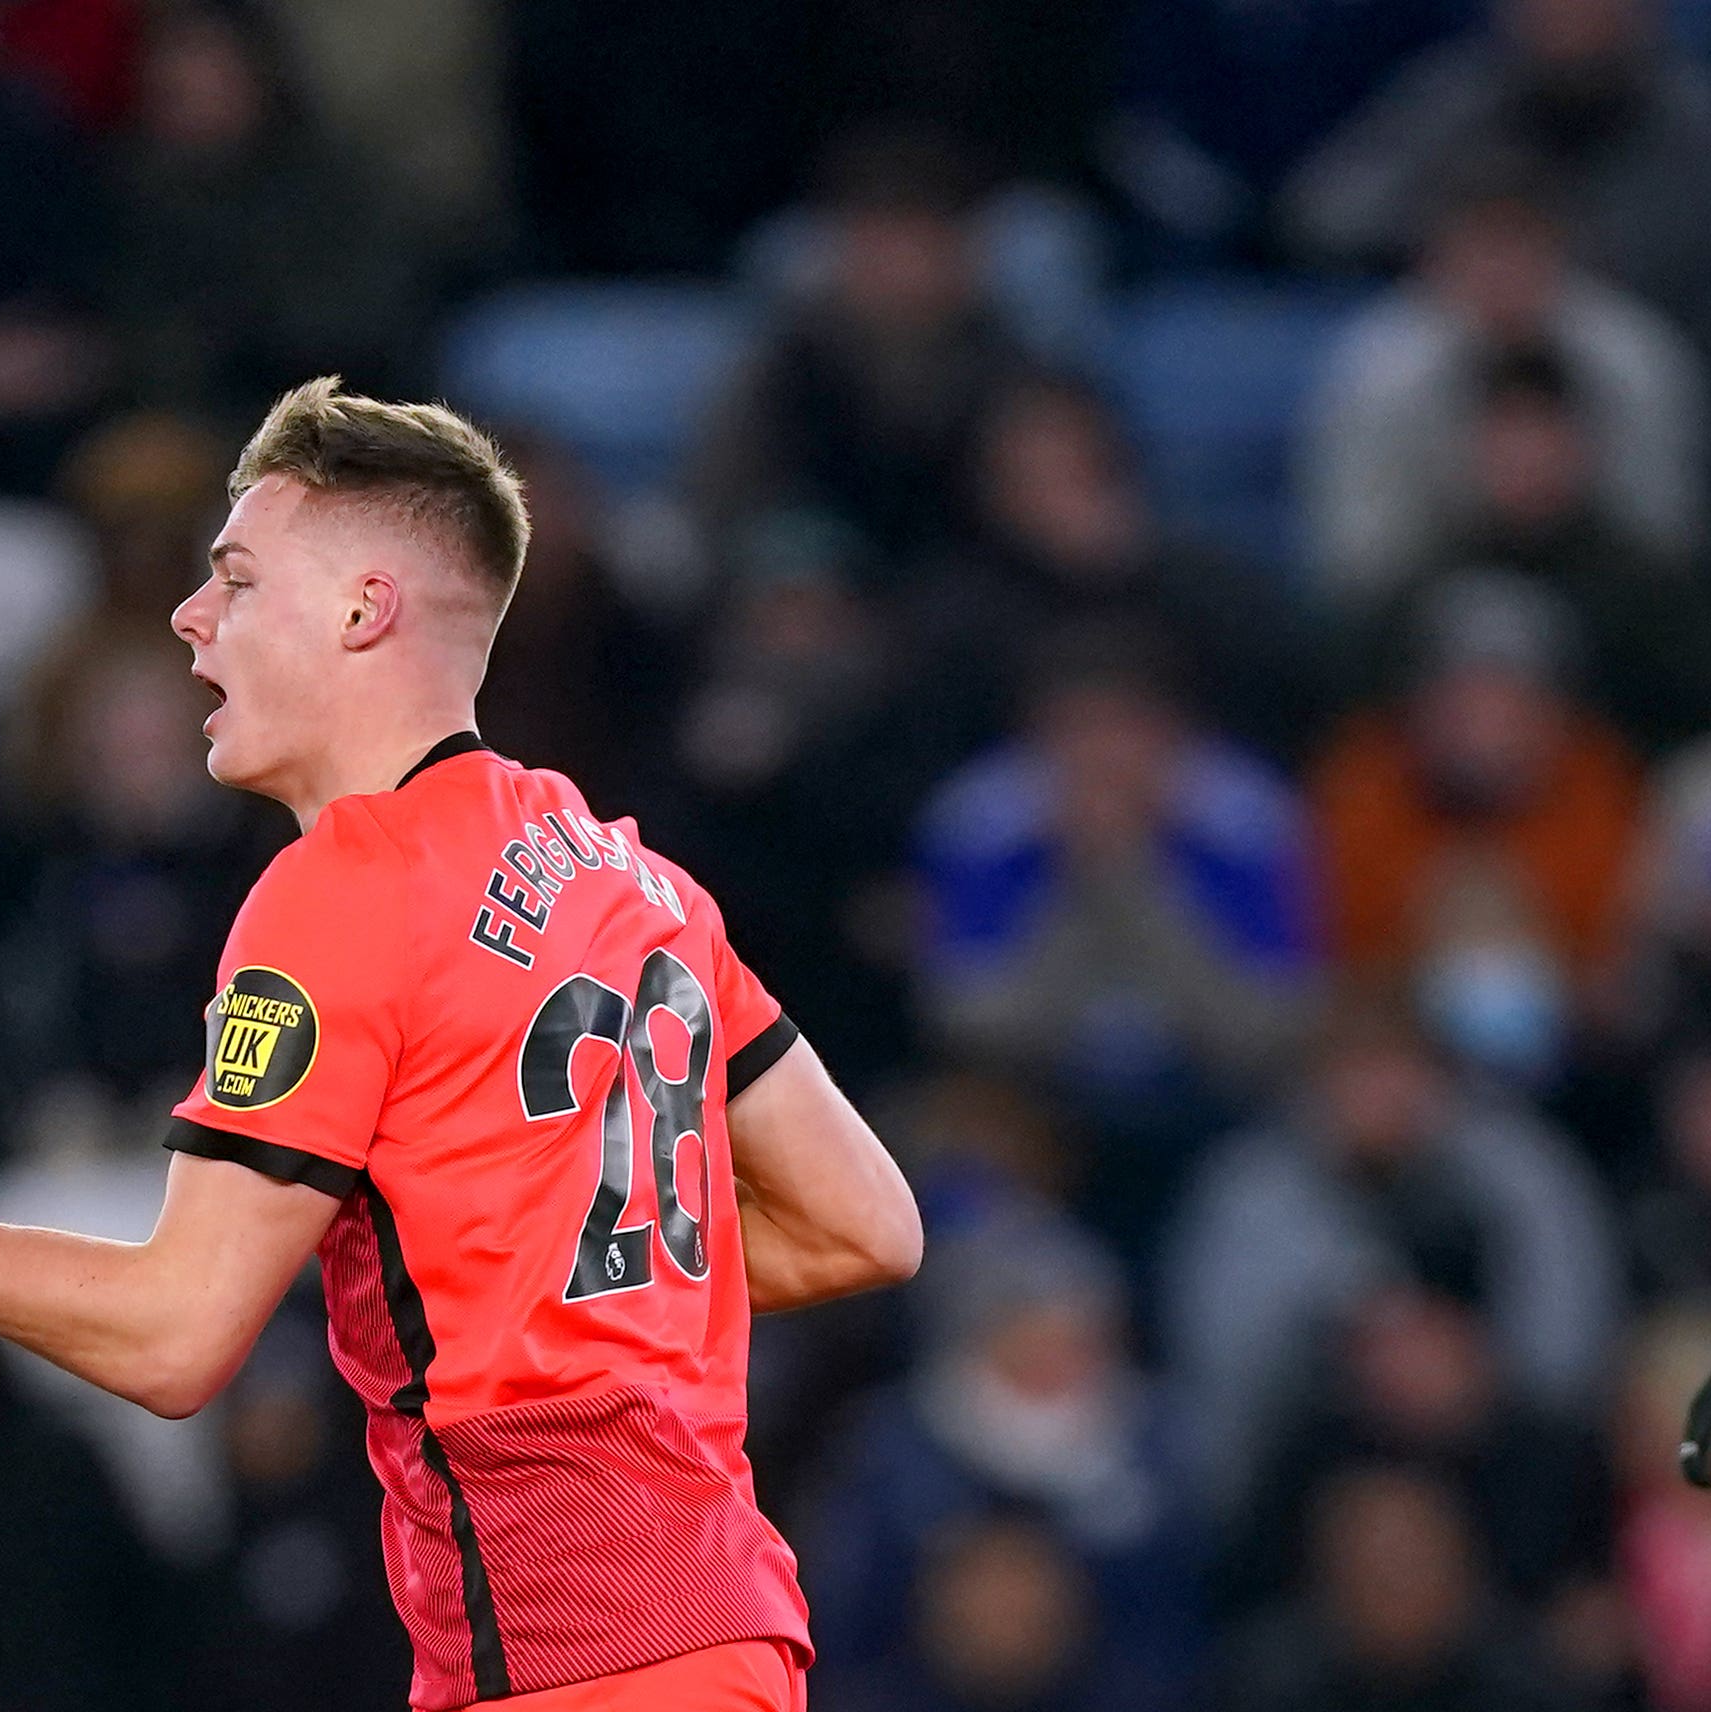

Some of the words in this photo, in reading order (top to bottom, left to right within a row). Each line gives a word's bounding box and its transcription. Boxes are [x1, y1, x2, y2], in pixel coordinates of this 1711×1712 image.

[469, 808, 686, 971] FERGUSN
[217, 983, 304, 1028] SNICKERS
[221, 1024, 270, 1069] UK
[217, 1075, 256, 1097] .COM
[517, 946, 713, 1304] 28
